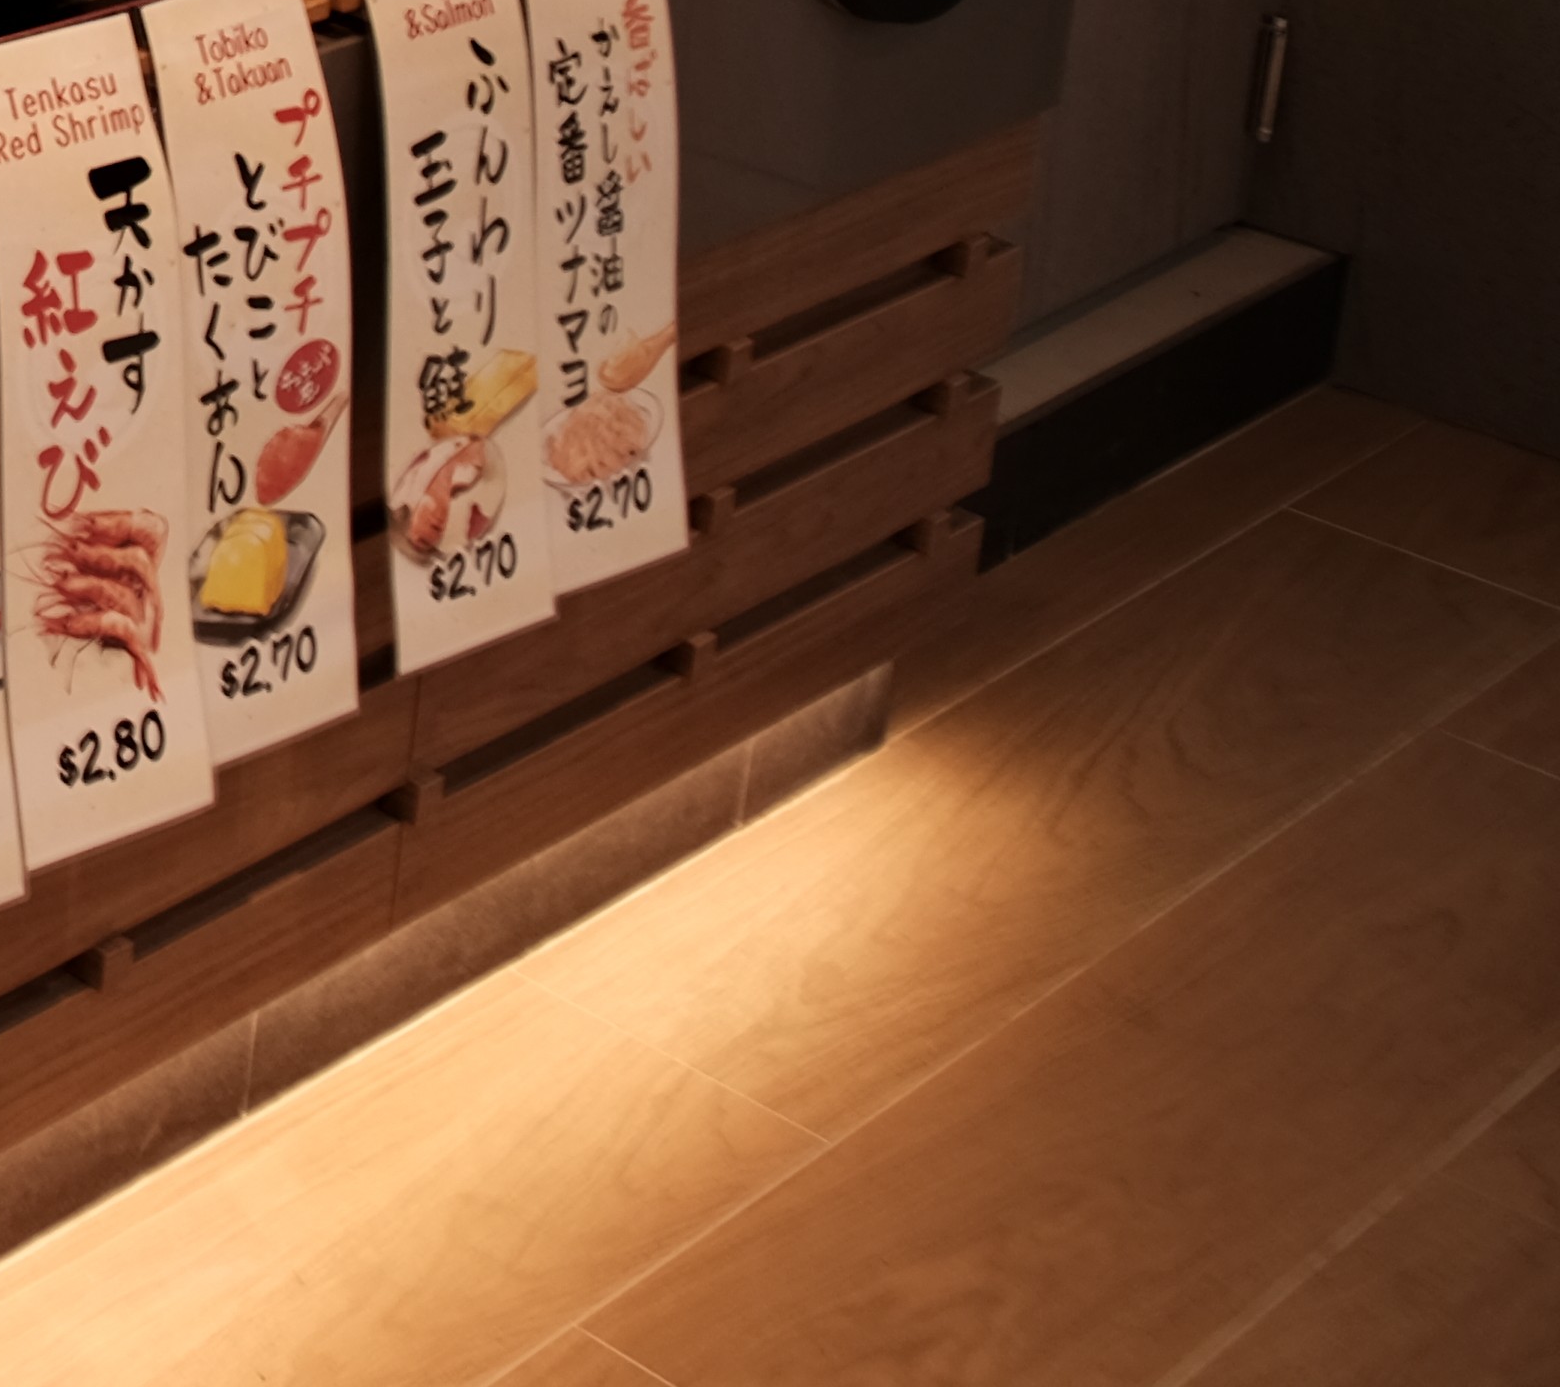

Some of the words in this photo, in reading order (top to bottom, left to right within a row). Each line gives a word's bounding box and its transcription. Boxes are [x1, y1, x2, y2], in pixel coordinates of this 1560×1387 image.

[3, 73, 118, 124] Tenkasu
[52, 100, 146, 155] Shrimp
[194, 26, 269, 71] Tobiko
[87, 155, 161, 417] 天かす
[233, 153, 284, 401] とびこと
[273, 89, 333, 336] プチプチ
[409, 130, 471, 430] 玉子と鮭
[467, 39, 510, 347] ふんわり
[548, 38, 590, 408] 定番ツナマヨ
[19, 248, 112, 520] 紅えび
[182, 225, 247, 514] たくあん
[428, 532, 519, 604] $2.70
[566, 469, 653, 534] $2.70
[58, 707, 168, 788] $2.80
[220, 625, 317, 701] $2.70
